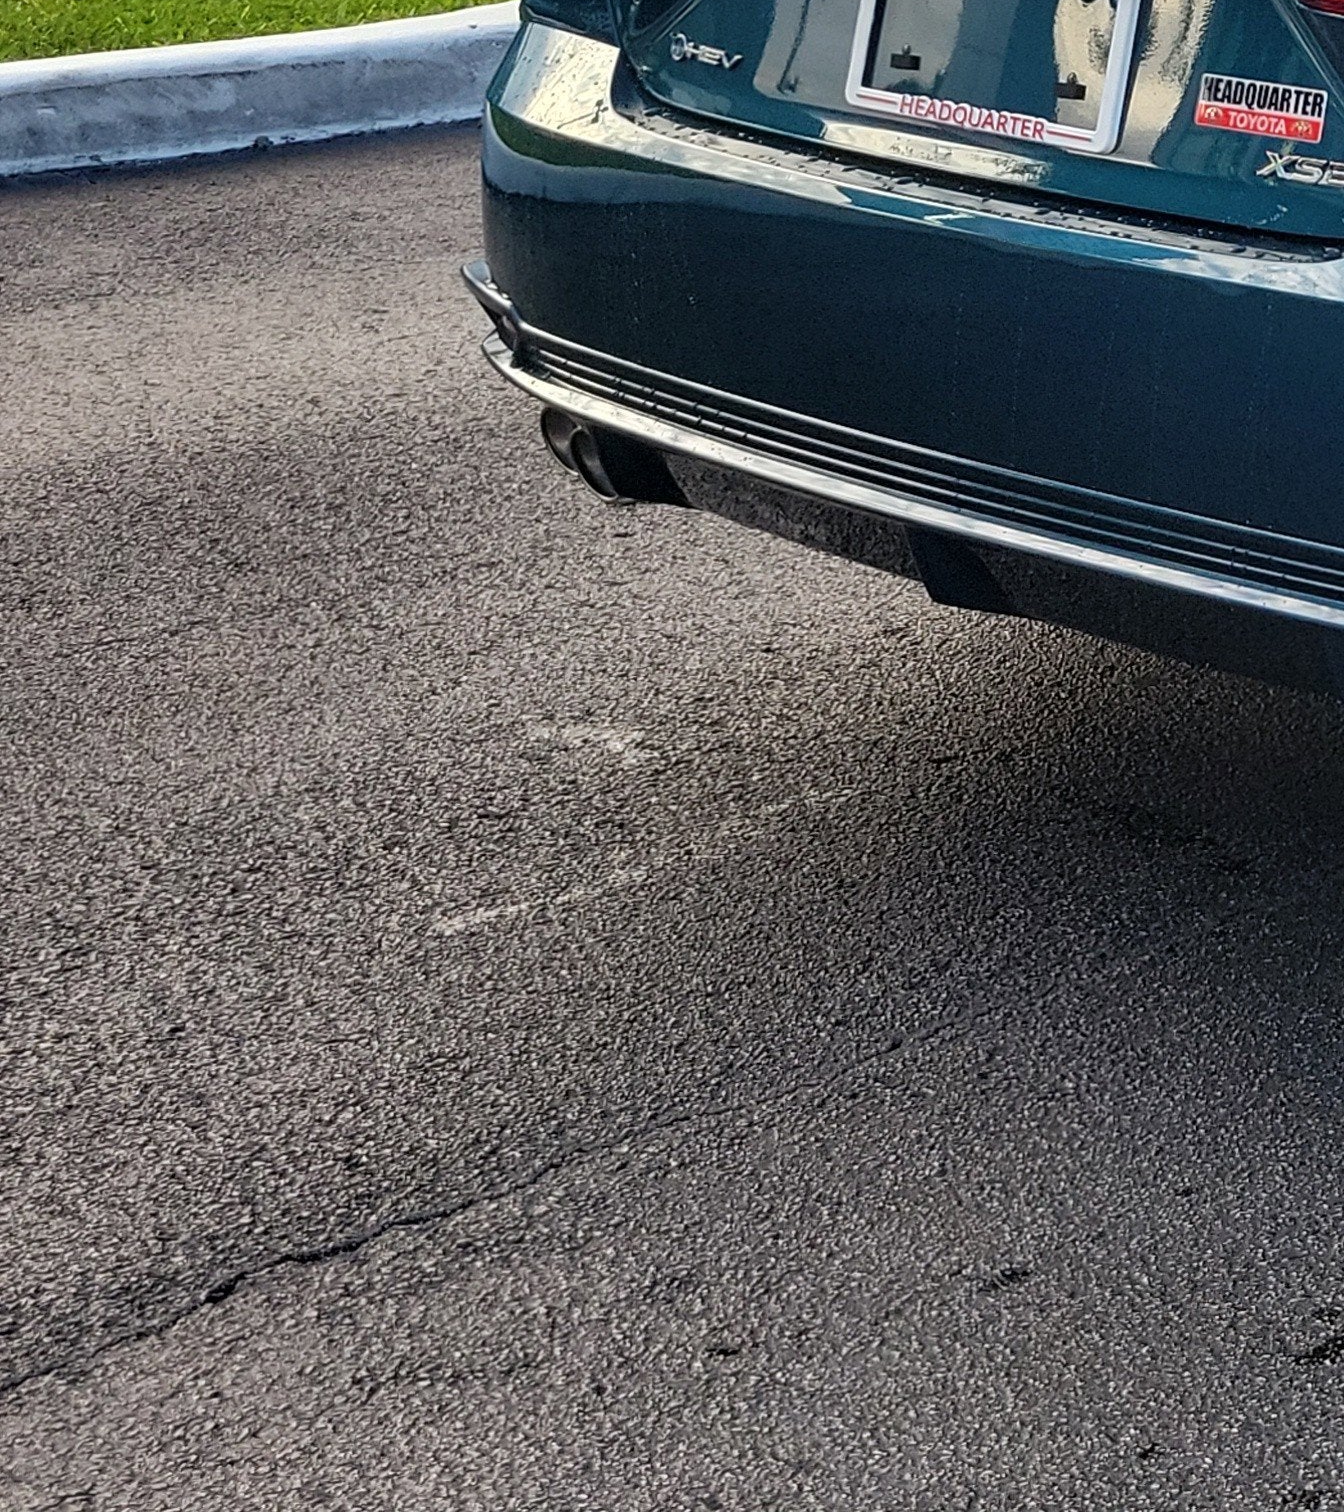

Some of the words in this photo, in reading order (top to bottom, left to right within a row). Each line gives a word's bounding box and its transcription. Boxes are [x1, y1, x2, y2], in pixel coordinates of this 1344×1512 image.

[900, 94, 1045, 140] HEADQUARTER
[1202, 75, 1325, 118] HEADQUARTER
[1227, 110, 1287, 135] TOYOTA
